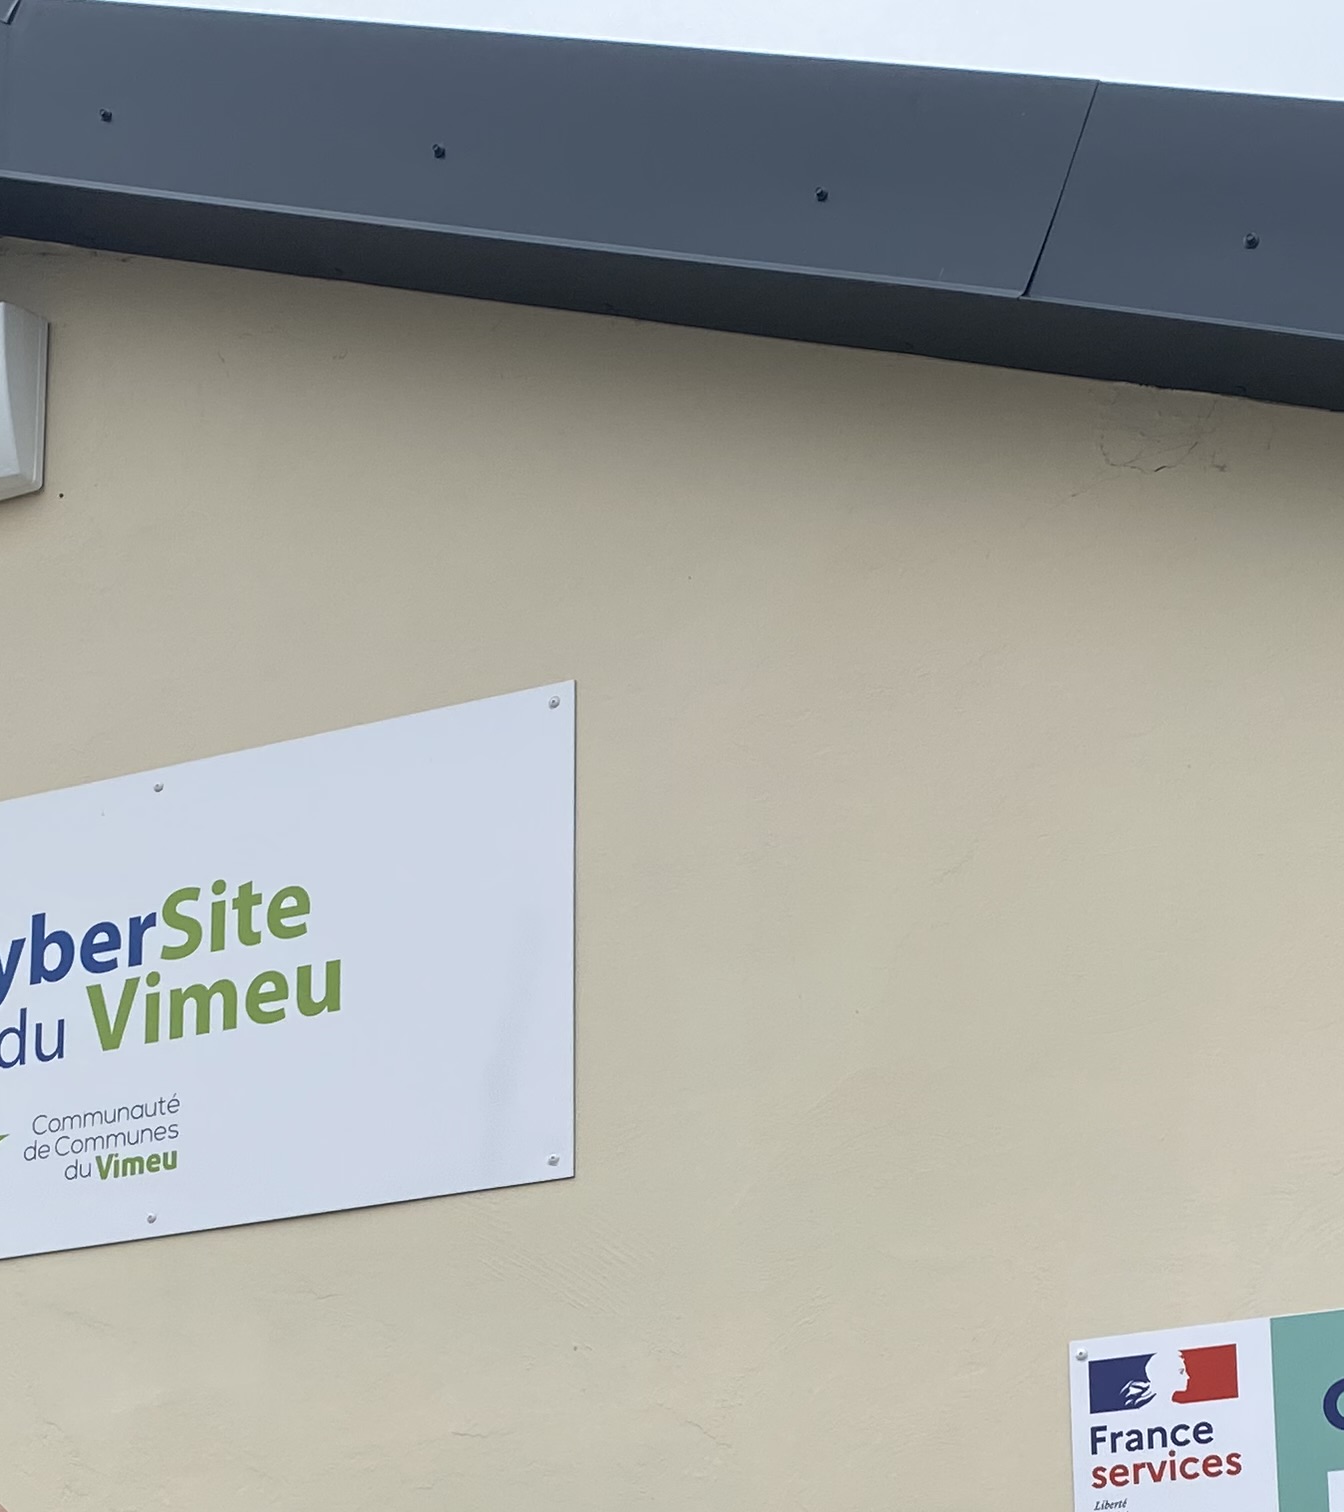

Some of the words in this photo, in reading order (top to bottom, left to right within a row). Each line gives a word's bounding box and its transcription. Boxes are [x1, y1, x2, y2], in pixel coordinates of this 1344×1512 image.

[86, 960, 342, 1052] Vimeu
[32, 1093, 180, 1135] Communauté
[23, 1137, 52, 1161] de
[55, 1122, 180, 1156] Communes
[64, 1159, 92, 1181] du
[94, 1150, 179, 1181] Vimeu
[1090, 1421, 1214, 1455] France
[1091, 1450, 1242, 1489] services
[1094, 1498, 1128, 1511] Liberté
